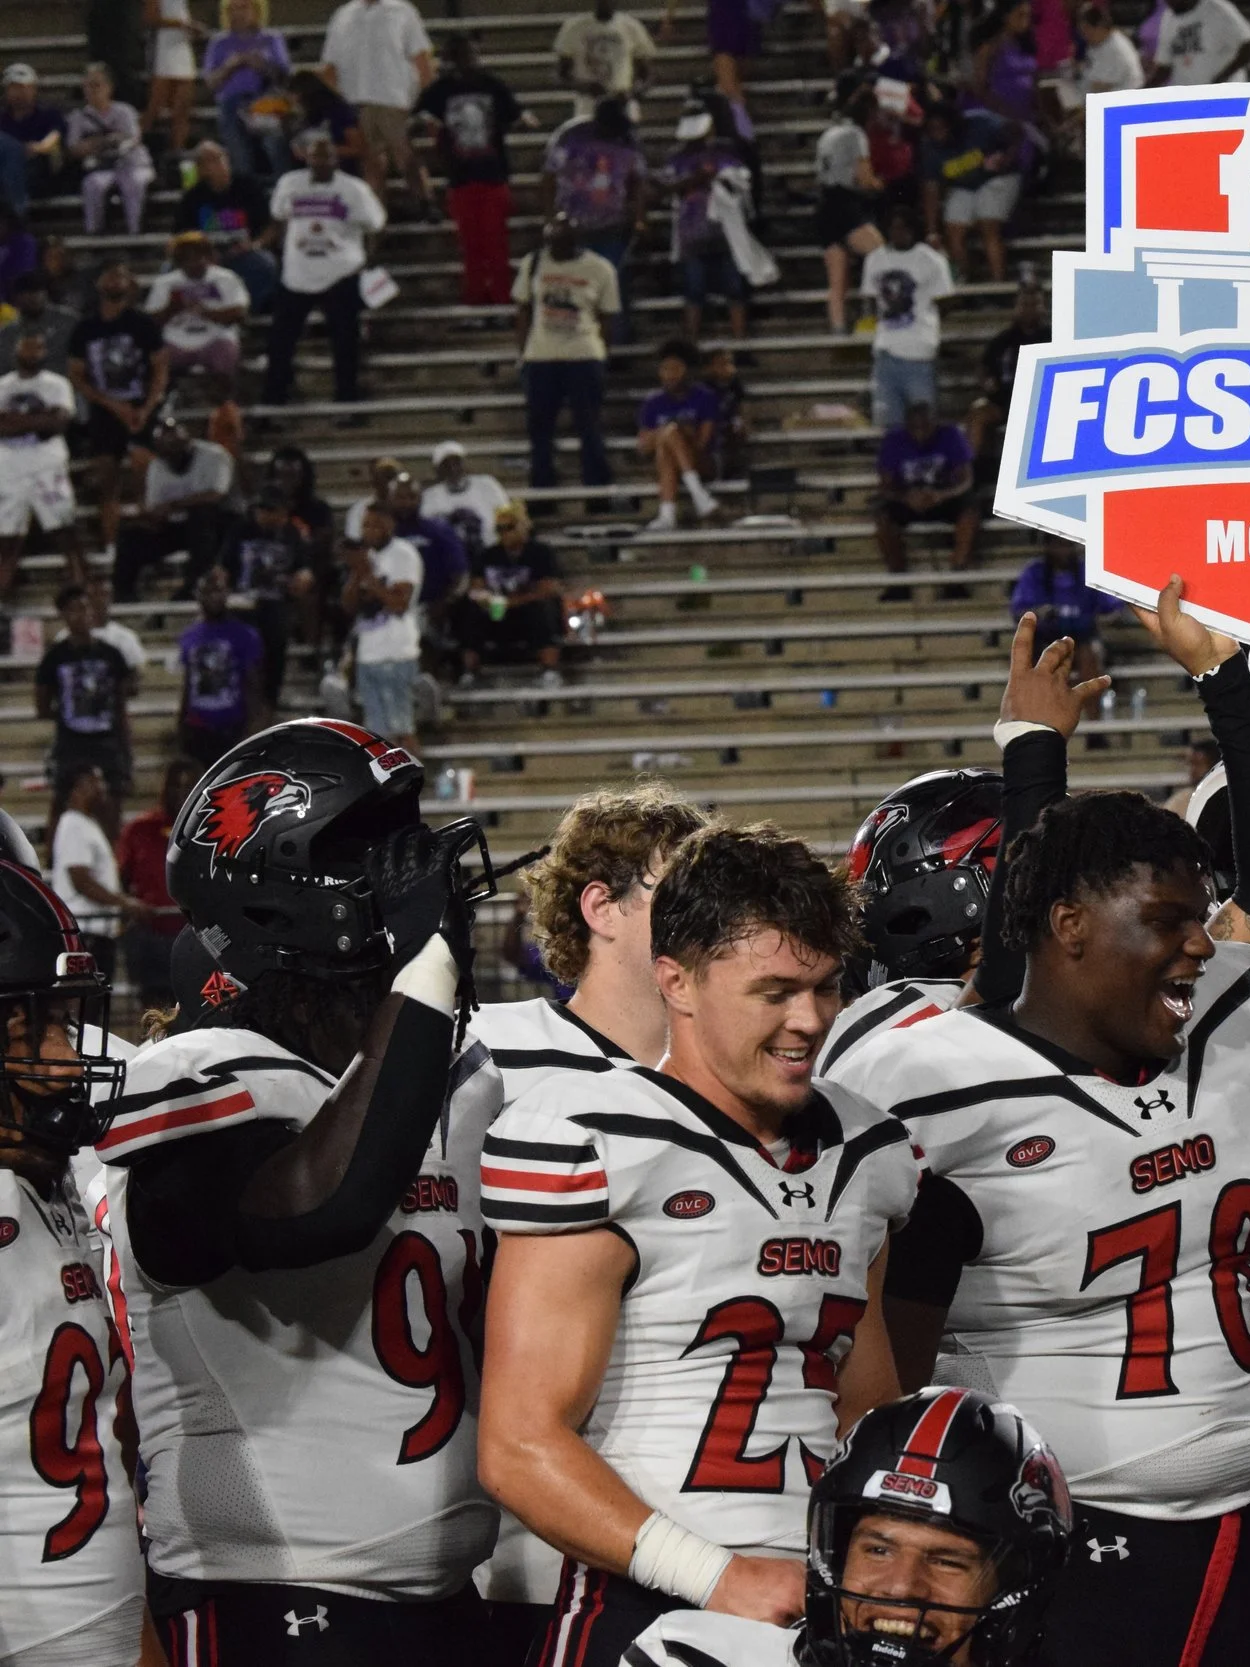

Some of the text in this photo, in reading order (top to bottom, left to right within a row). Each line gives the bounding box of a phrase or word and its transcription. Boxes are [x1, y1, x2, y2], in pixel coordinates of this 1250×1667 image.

[1017, 1142, 1044, 1162] OVC
[1130, 1134, 1216, 1195] SEMO
[400, 1175, 459, 1213] SEMO
[674, 1198, 702, 1212] OVC
[757, 1237, 842, 1278] SEMO
[880, 1473, 939, 1499] SEMO
[871, 1642, 907, 1661] Riddell
